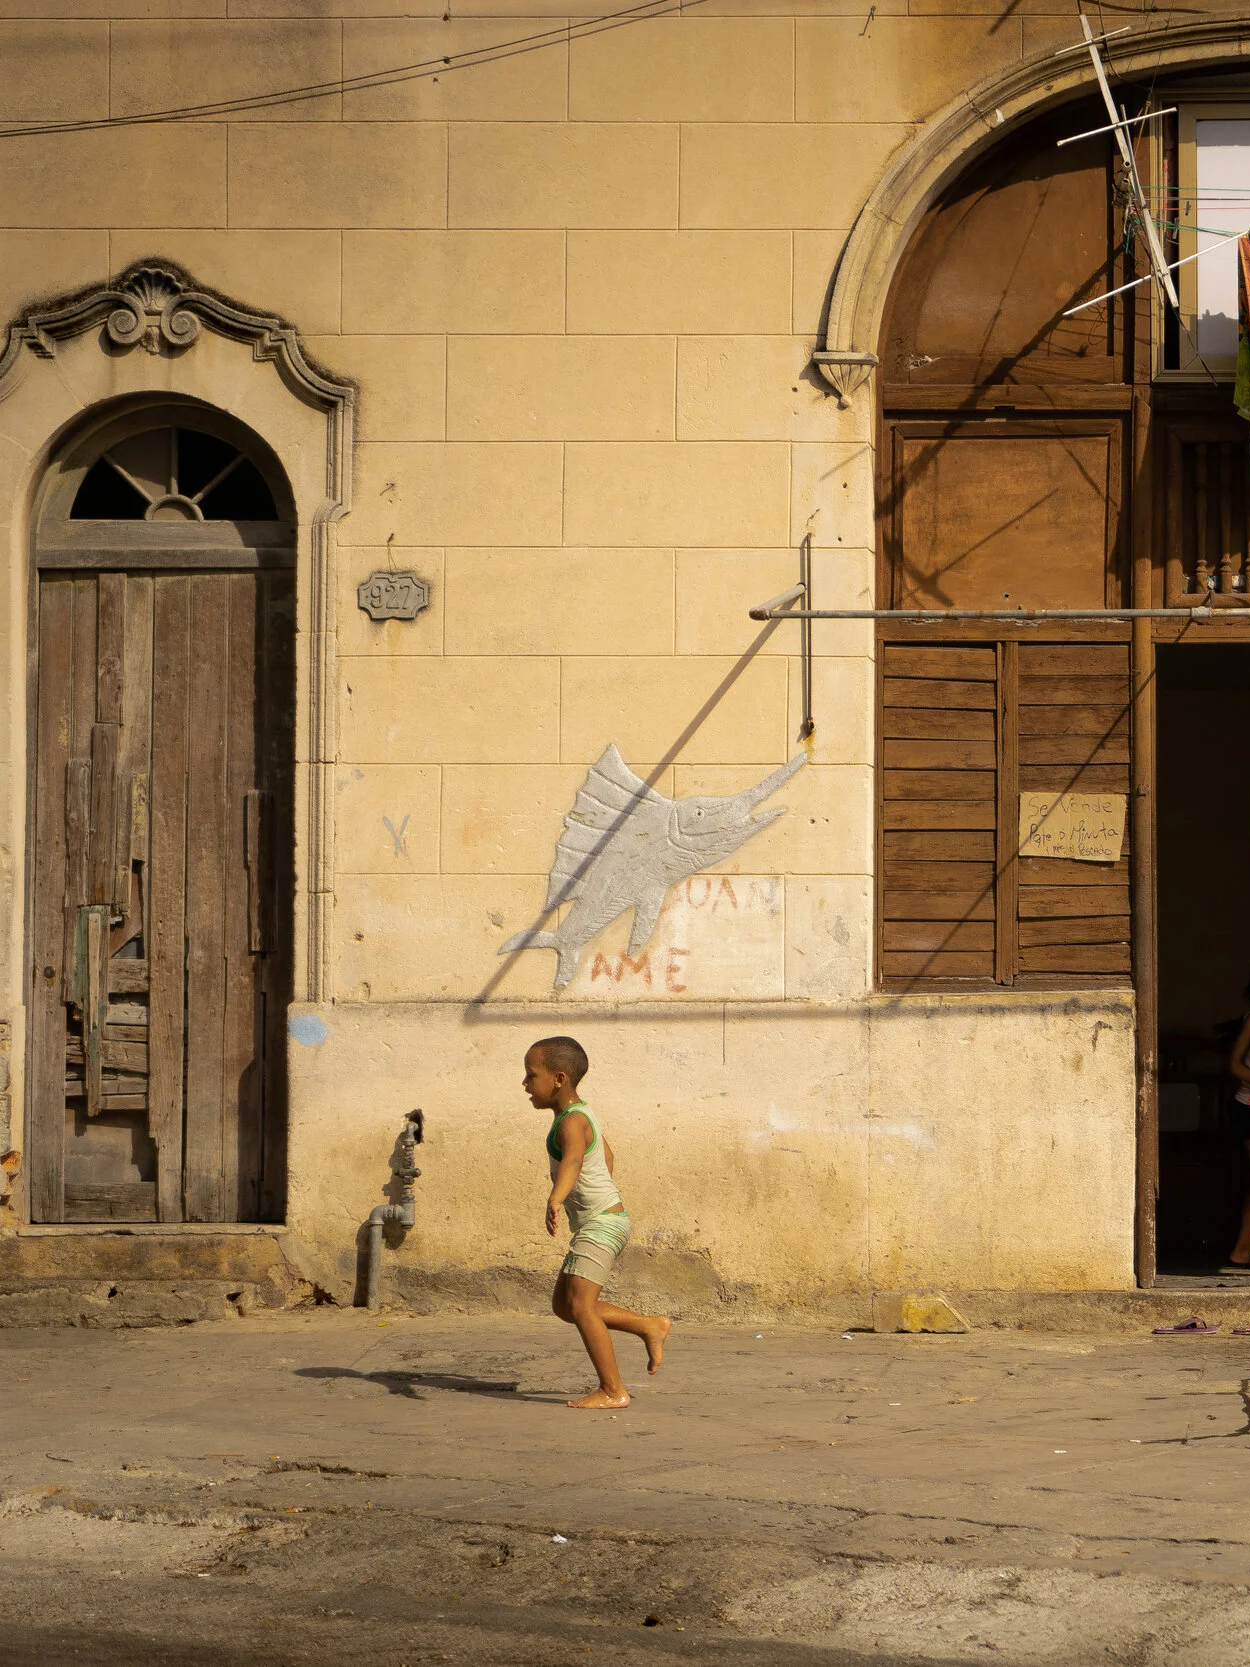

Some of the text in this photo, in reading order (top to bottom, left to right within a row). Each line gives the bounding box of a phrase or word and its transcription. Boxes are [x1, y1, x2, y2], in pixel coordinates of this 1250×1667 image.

[370, 585, 411, 610] 927
[1028, 796, 1112, 819] Se Vende
[1070, 820, 1118, 842] Minuta
